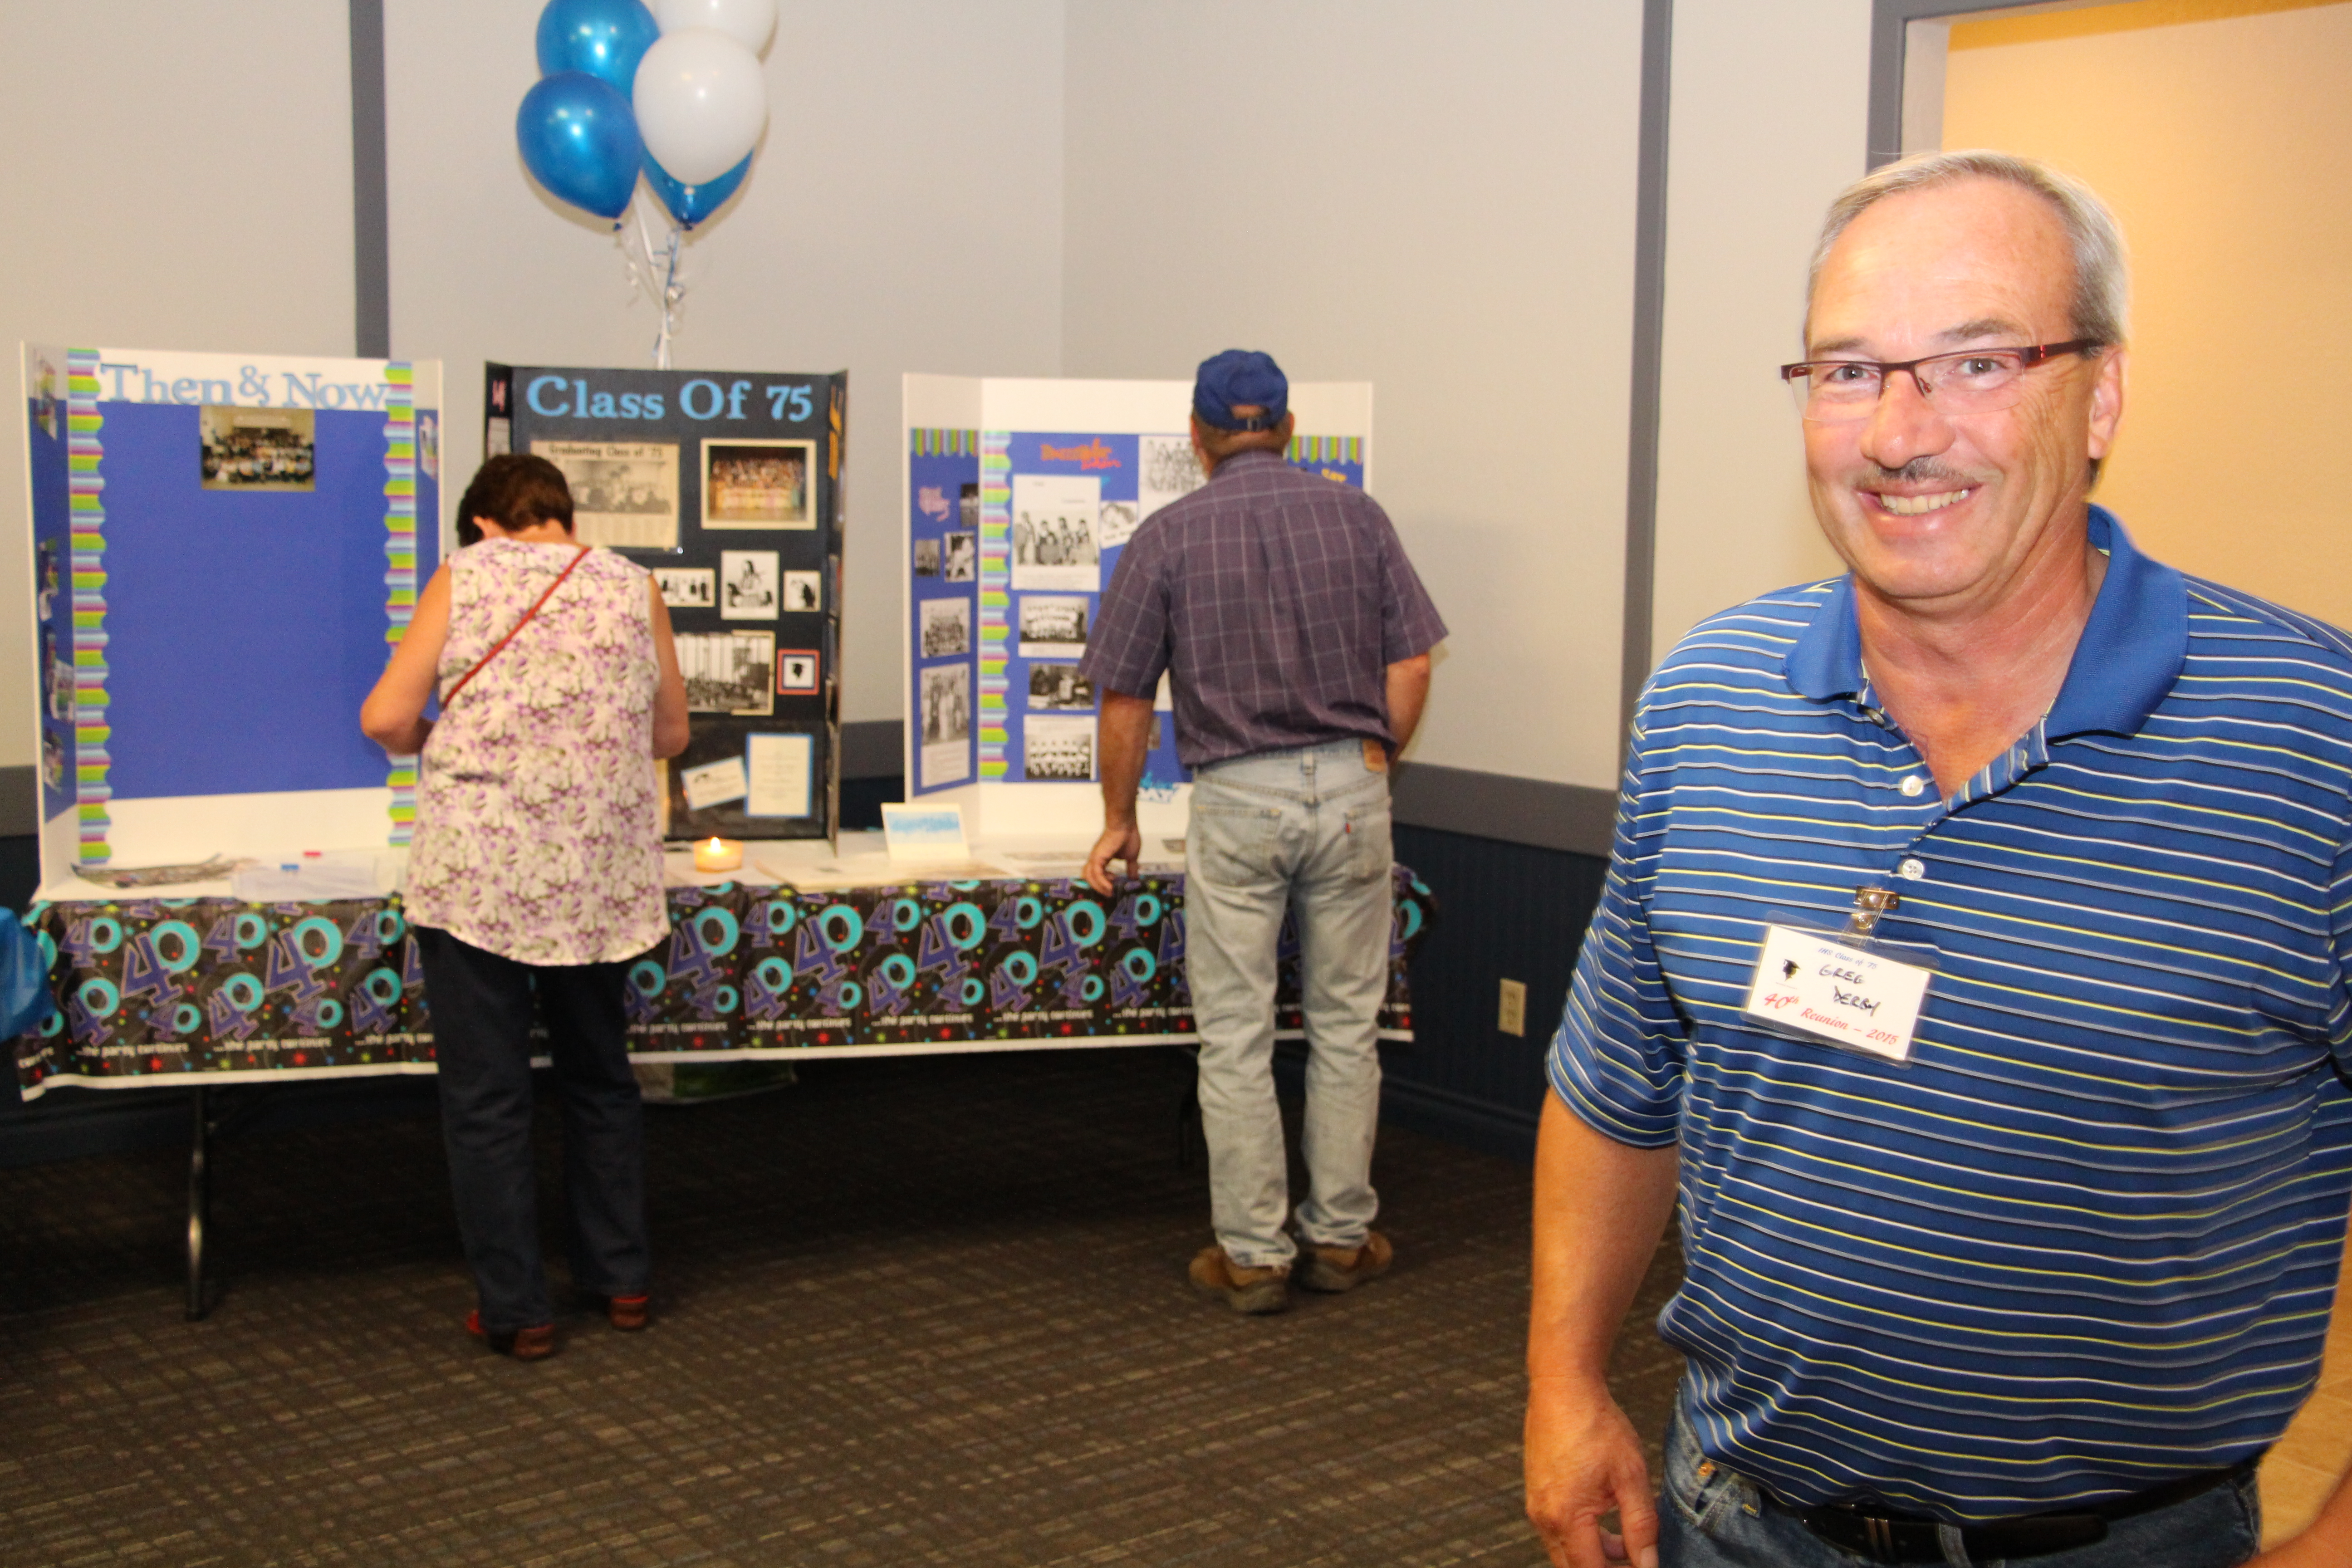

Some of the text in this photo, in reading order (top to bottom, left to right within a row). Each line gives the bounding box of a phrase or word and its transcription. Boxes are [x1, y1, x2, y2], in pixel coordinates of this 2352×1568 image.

[100, 363, 390, 411] Then & Now
[526, 375, 666, 420] Class
[679, 379, 752, 420] Of
[765, 384, 814, 422] 75
[1818, 964, 1865, 985] GREG
[1835, 952, 1853, 962] Class
[1764, 993, 1800, 1009] 40th
[1800, 1008, 1849, 1030] Reunion
[1866, 1029, 1900, 1045] 2015
